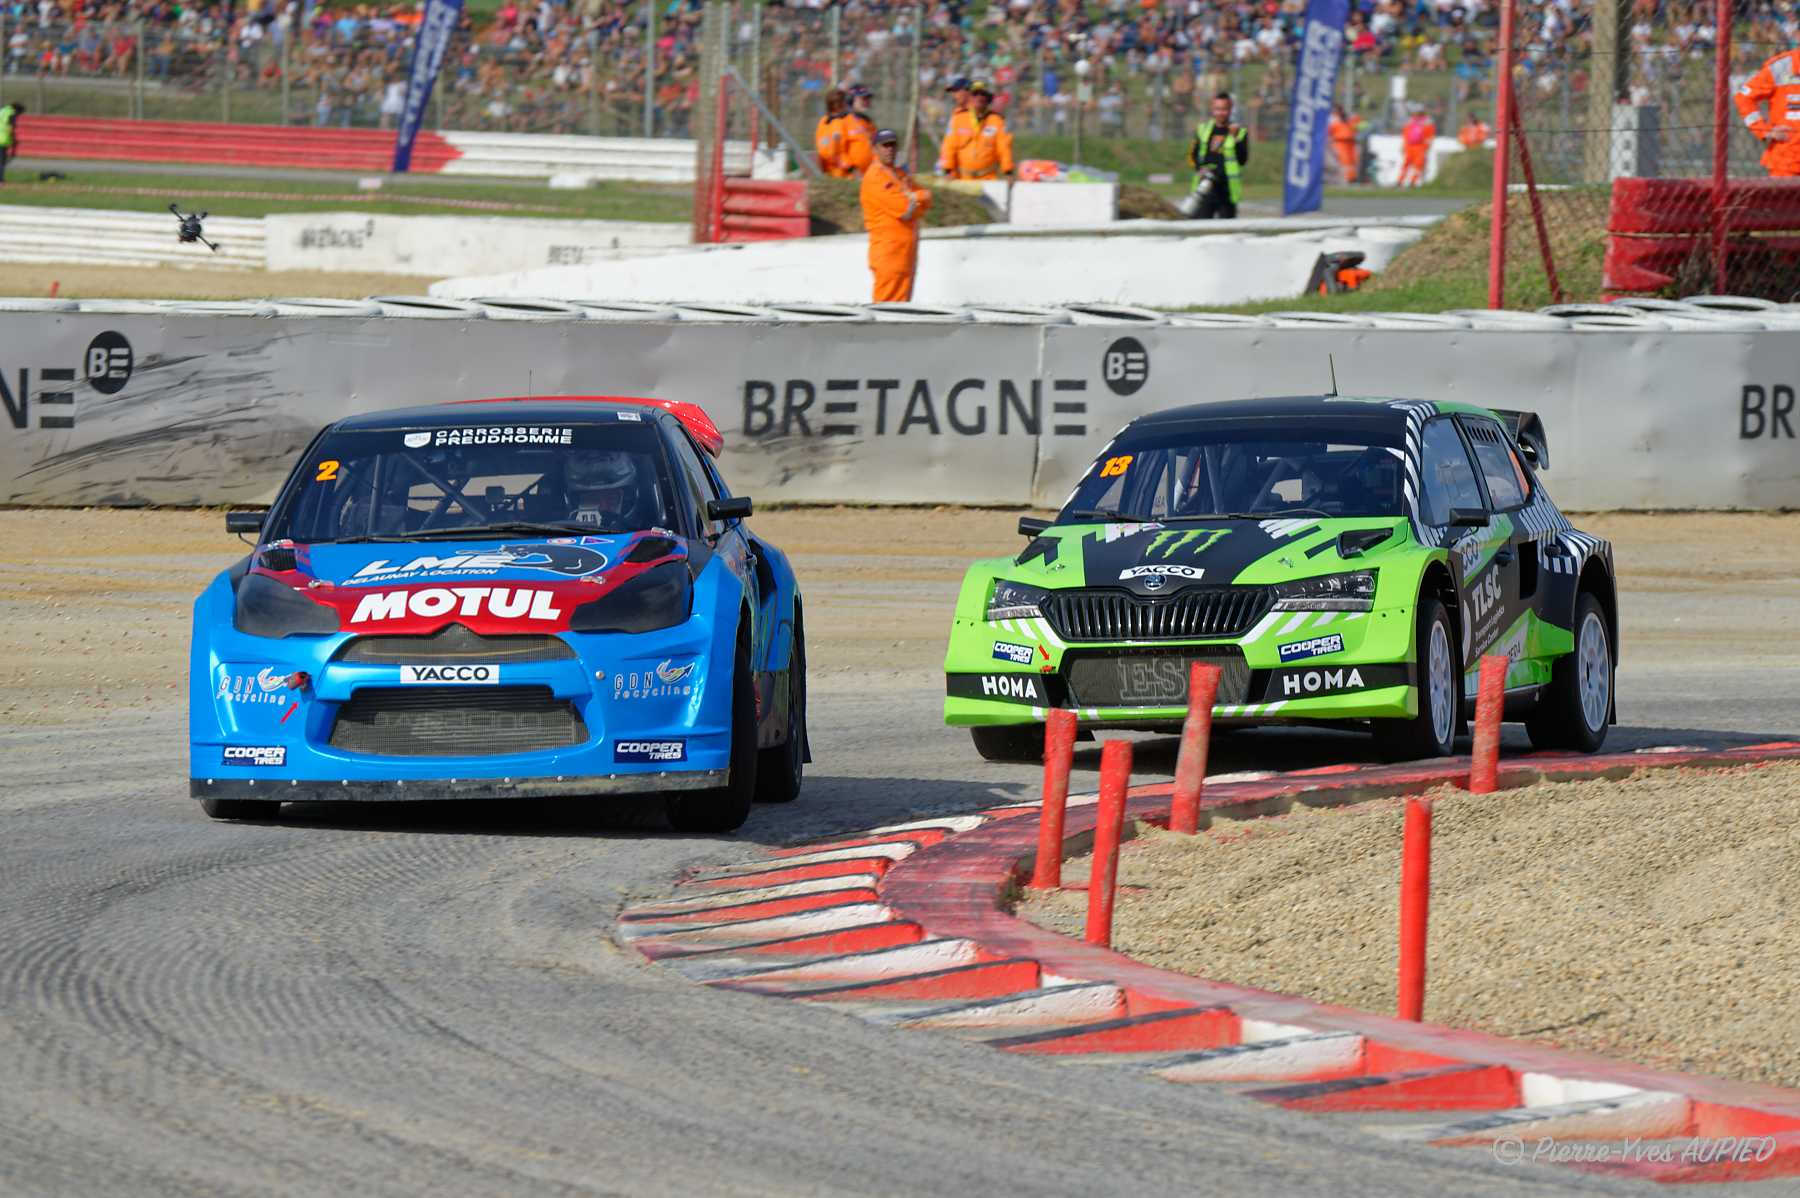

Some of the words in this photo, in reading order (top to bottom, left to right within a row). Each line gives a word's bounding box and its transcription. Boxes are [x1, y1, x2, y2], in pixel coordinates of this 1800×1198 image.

[743, 379, 1086, 436] BRETAGNE
[1740, 384, 1795, 439] BR
[436, 428, 573, 437] CARROSSERIE
[435, 435, 572, 446] PREUDHOMME
[316, 460, 340, 481] 2
[1100, 455, 1134, 478] 13
[341, 571, 419, 586] DELAUNAY
[419, 568, 498, 578] LOCATION
[1131, 566, 1195, 576] YACCO
[1472, 564, 1502, 622] TLSC
[350, 588, 561, 623] MOTUL
[995, 642, 1032, 656] COOPER
[1281, 635, 1341, 655] COOPER
[1311, 643, 1341, 655] TIRES
[411, 666, 490, 681] YACCO
[614, 671, 654, 690] GDN
[981, 676, 1038, 698] HOMA
[1283, 668, 1364, 695] HOMA
[614, 685, 691, 700] recycling
[224, 747, 286, 758] COOPER
[617, 742, 683, 753] COOPER
[254, 757, 283, 765] TIRES
[649, 752, 682, 760] TIRES
